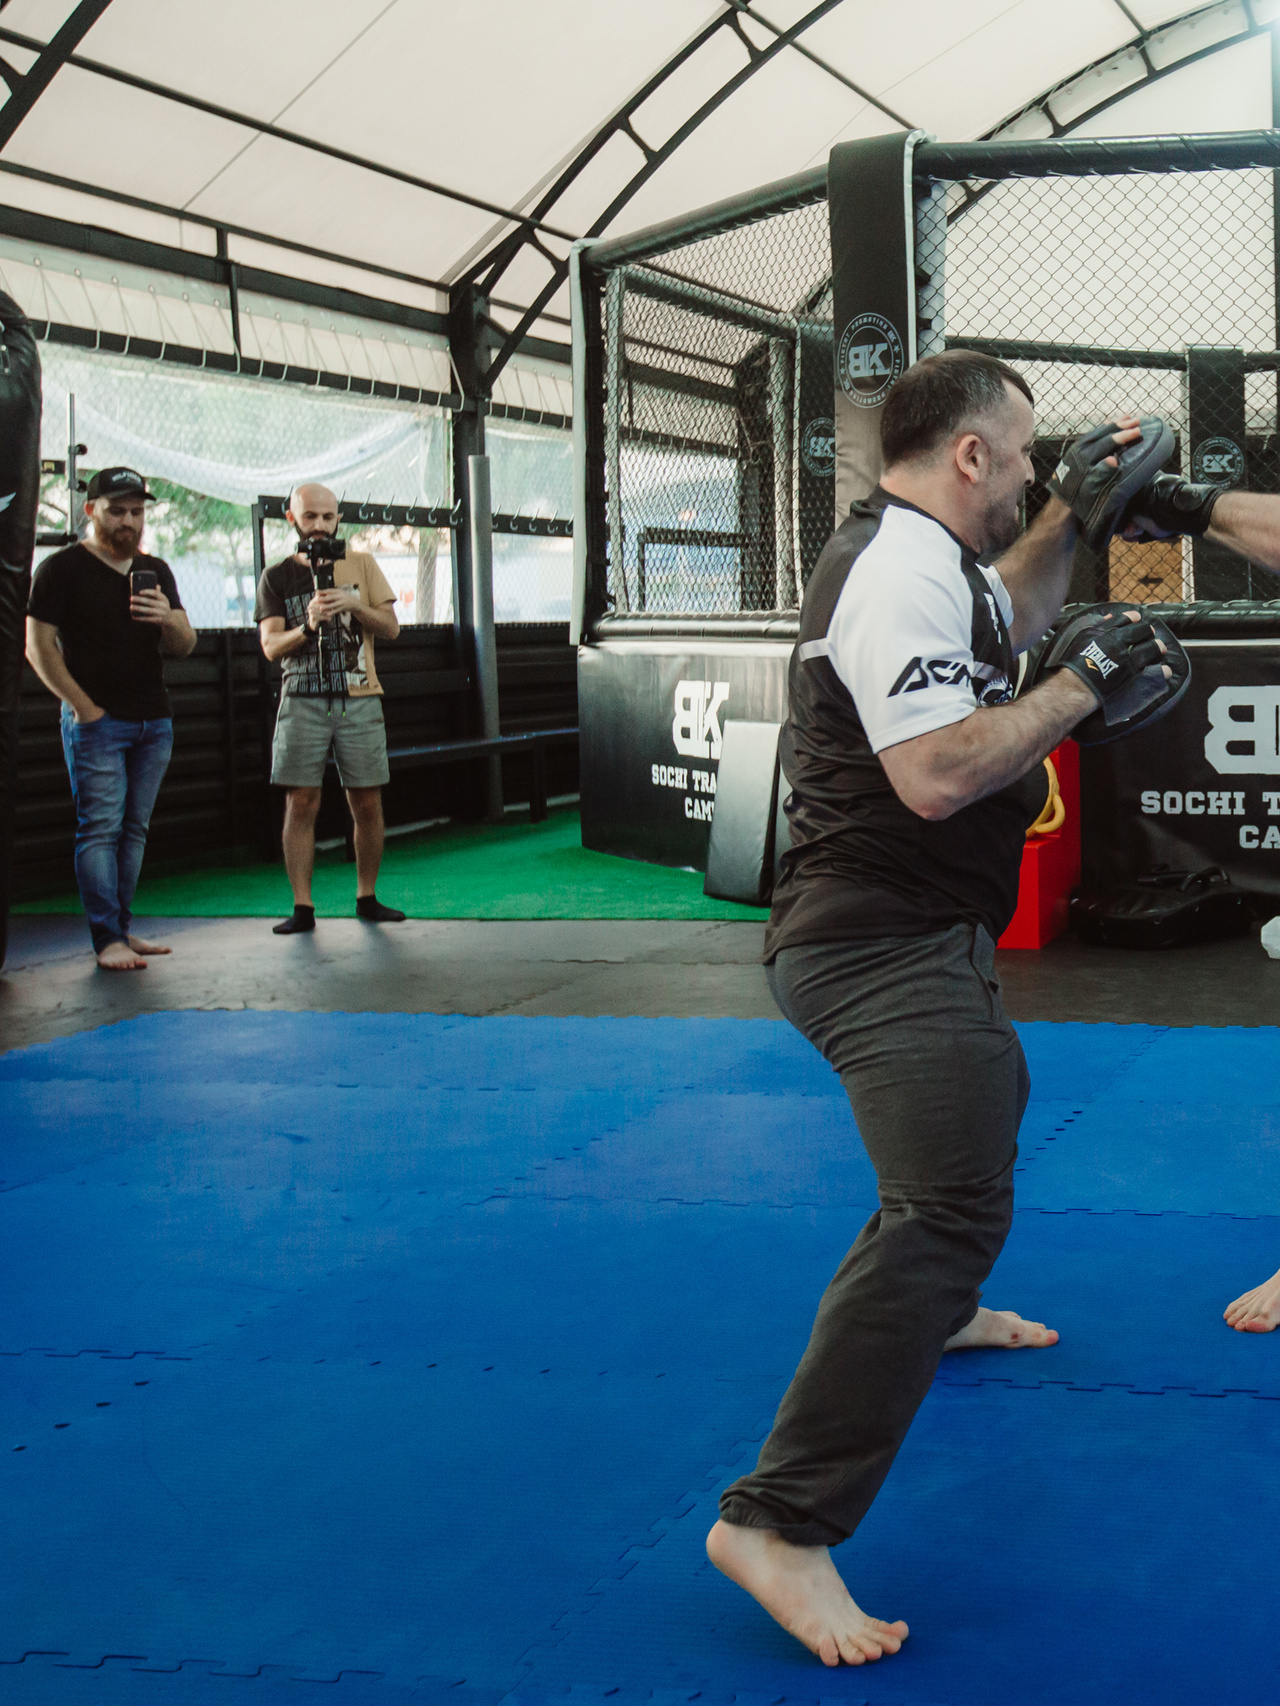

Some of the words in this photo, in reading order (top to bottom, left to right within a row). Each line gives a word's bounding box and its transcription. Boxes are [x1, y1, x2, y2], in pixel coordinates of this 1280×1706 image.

[848, 342, 891, 378] BK
[1079, 640, 1120, 680] EVERLAST
[672, 679, 731, 760] BK
[651, 763, 689, 790] SOCHI
[691, 769, 718, 794] TRA
[1140, 790, 1246, 816] SOCHI
